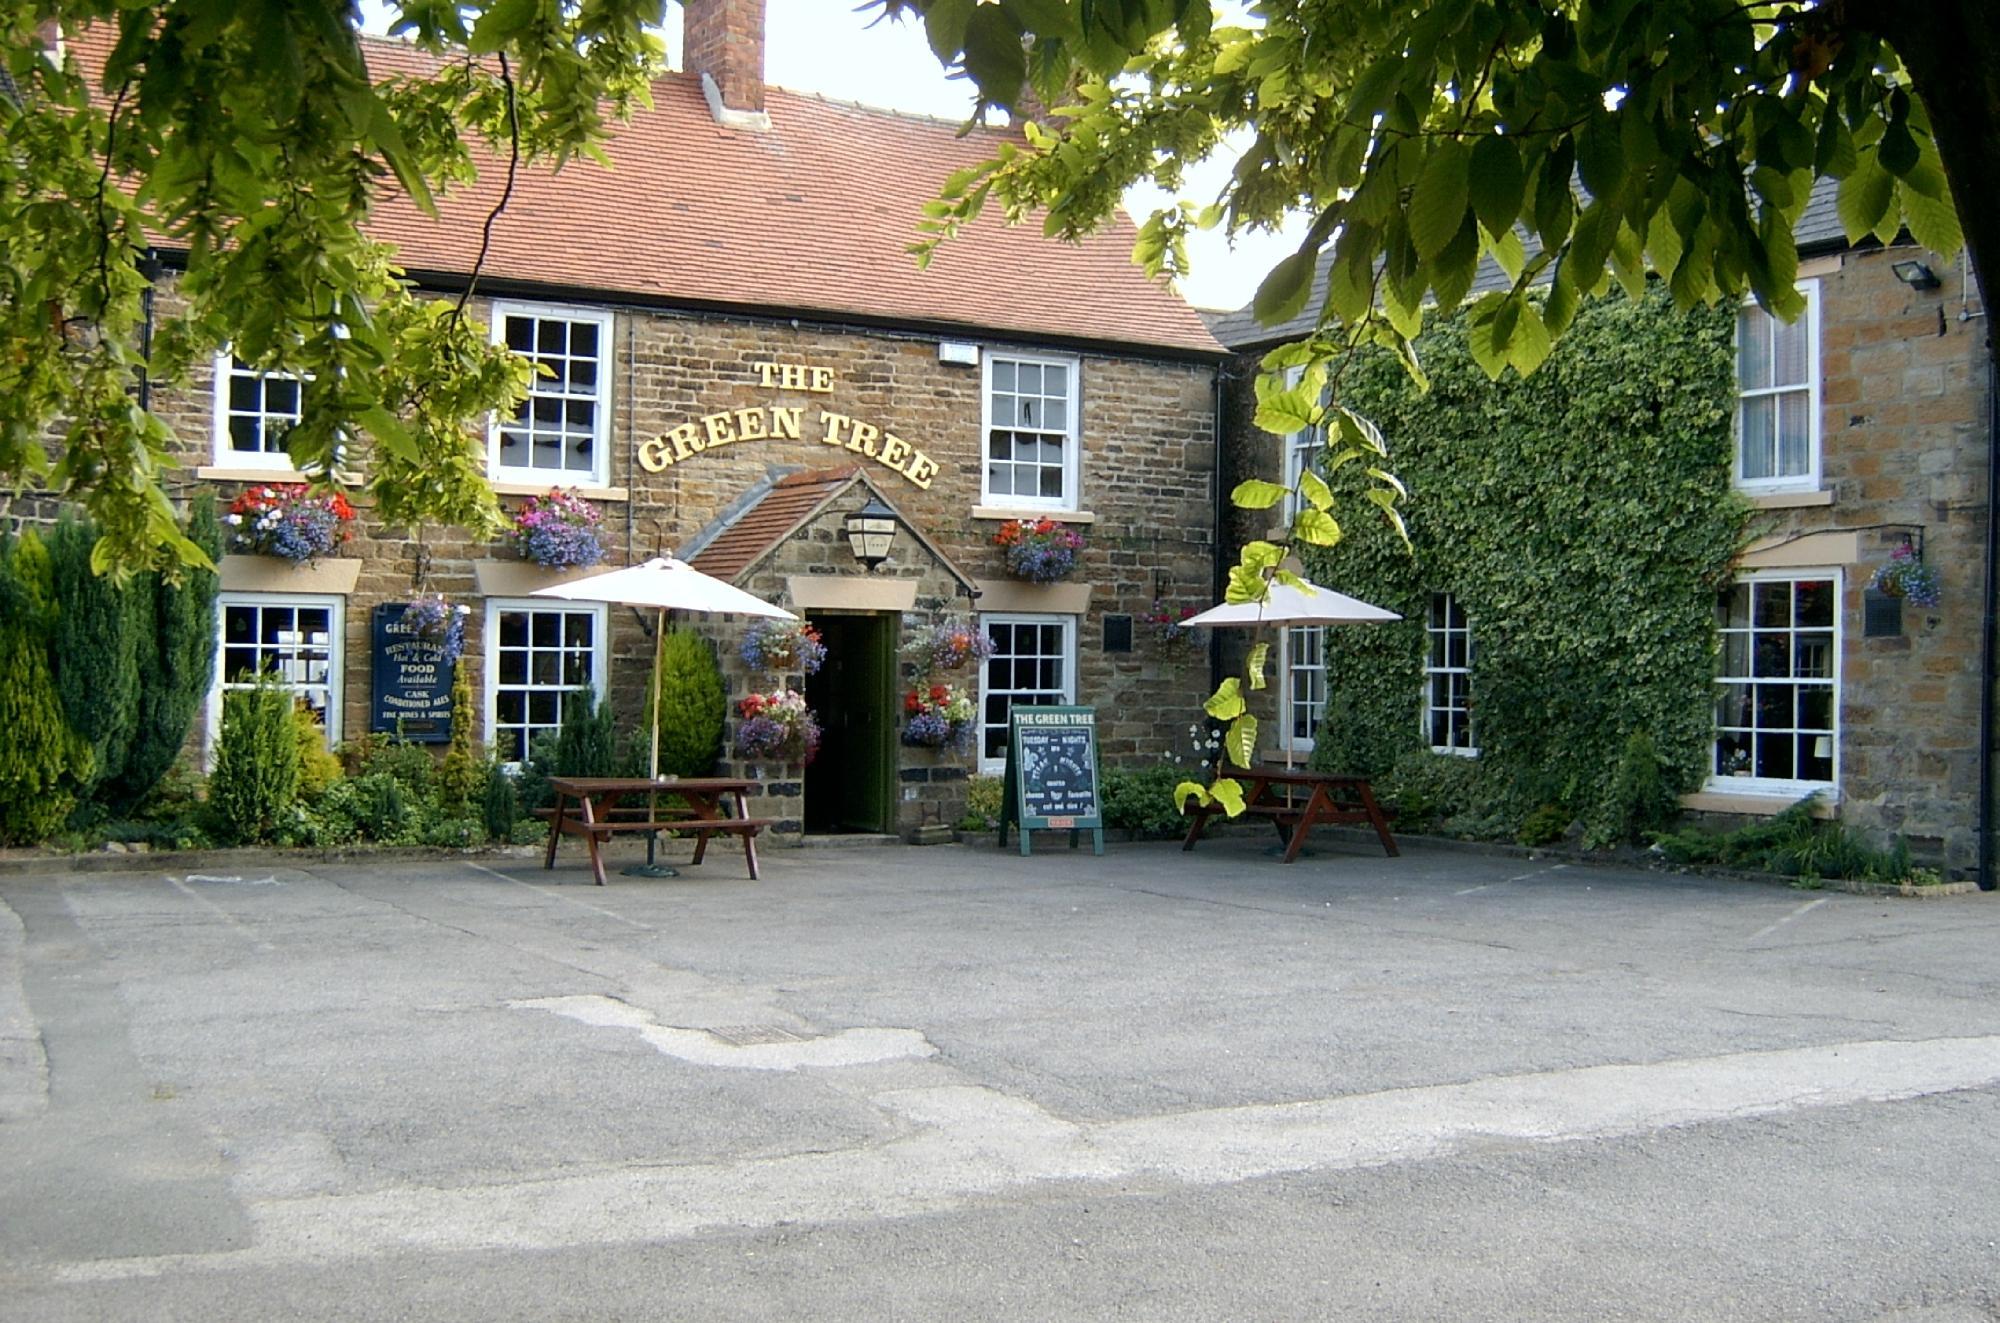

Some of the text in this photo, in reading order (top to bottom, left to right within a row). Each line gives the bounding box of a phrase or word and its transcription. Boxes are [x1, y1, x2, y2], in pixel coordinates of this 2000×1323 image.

[754, 362, 834, 392] THE
[637, 407, 940, 490] GREEN TREE
[412, 653, 420, 663] &
[423, 653, 442, 662] Cold
[400, 664, 435, 673] FOOD
[397, 674, 438, 684] Available
[404, 690, 430, 698] CASK
[383, 694, 449, 708] CONDITIONED ALES
[382, 711, 396, 719] FINE
[1013, 713, 1095, 725] THE GREEN TREE
[1021, 735, 1048, 744] TUESDAY
[1062, 736, 1086, 744] NIGHTS
